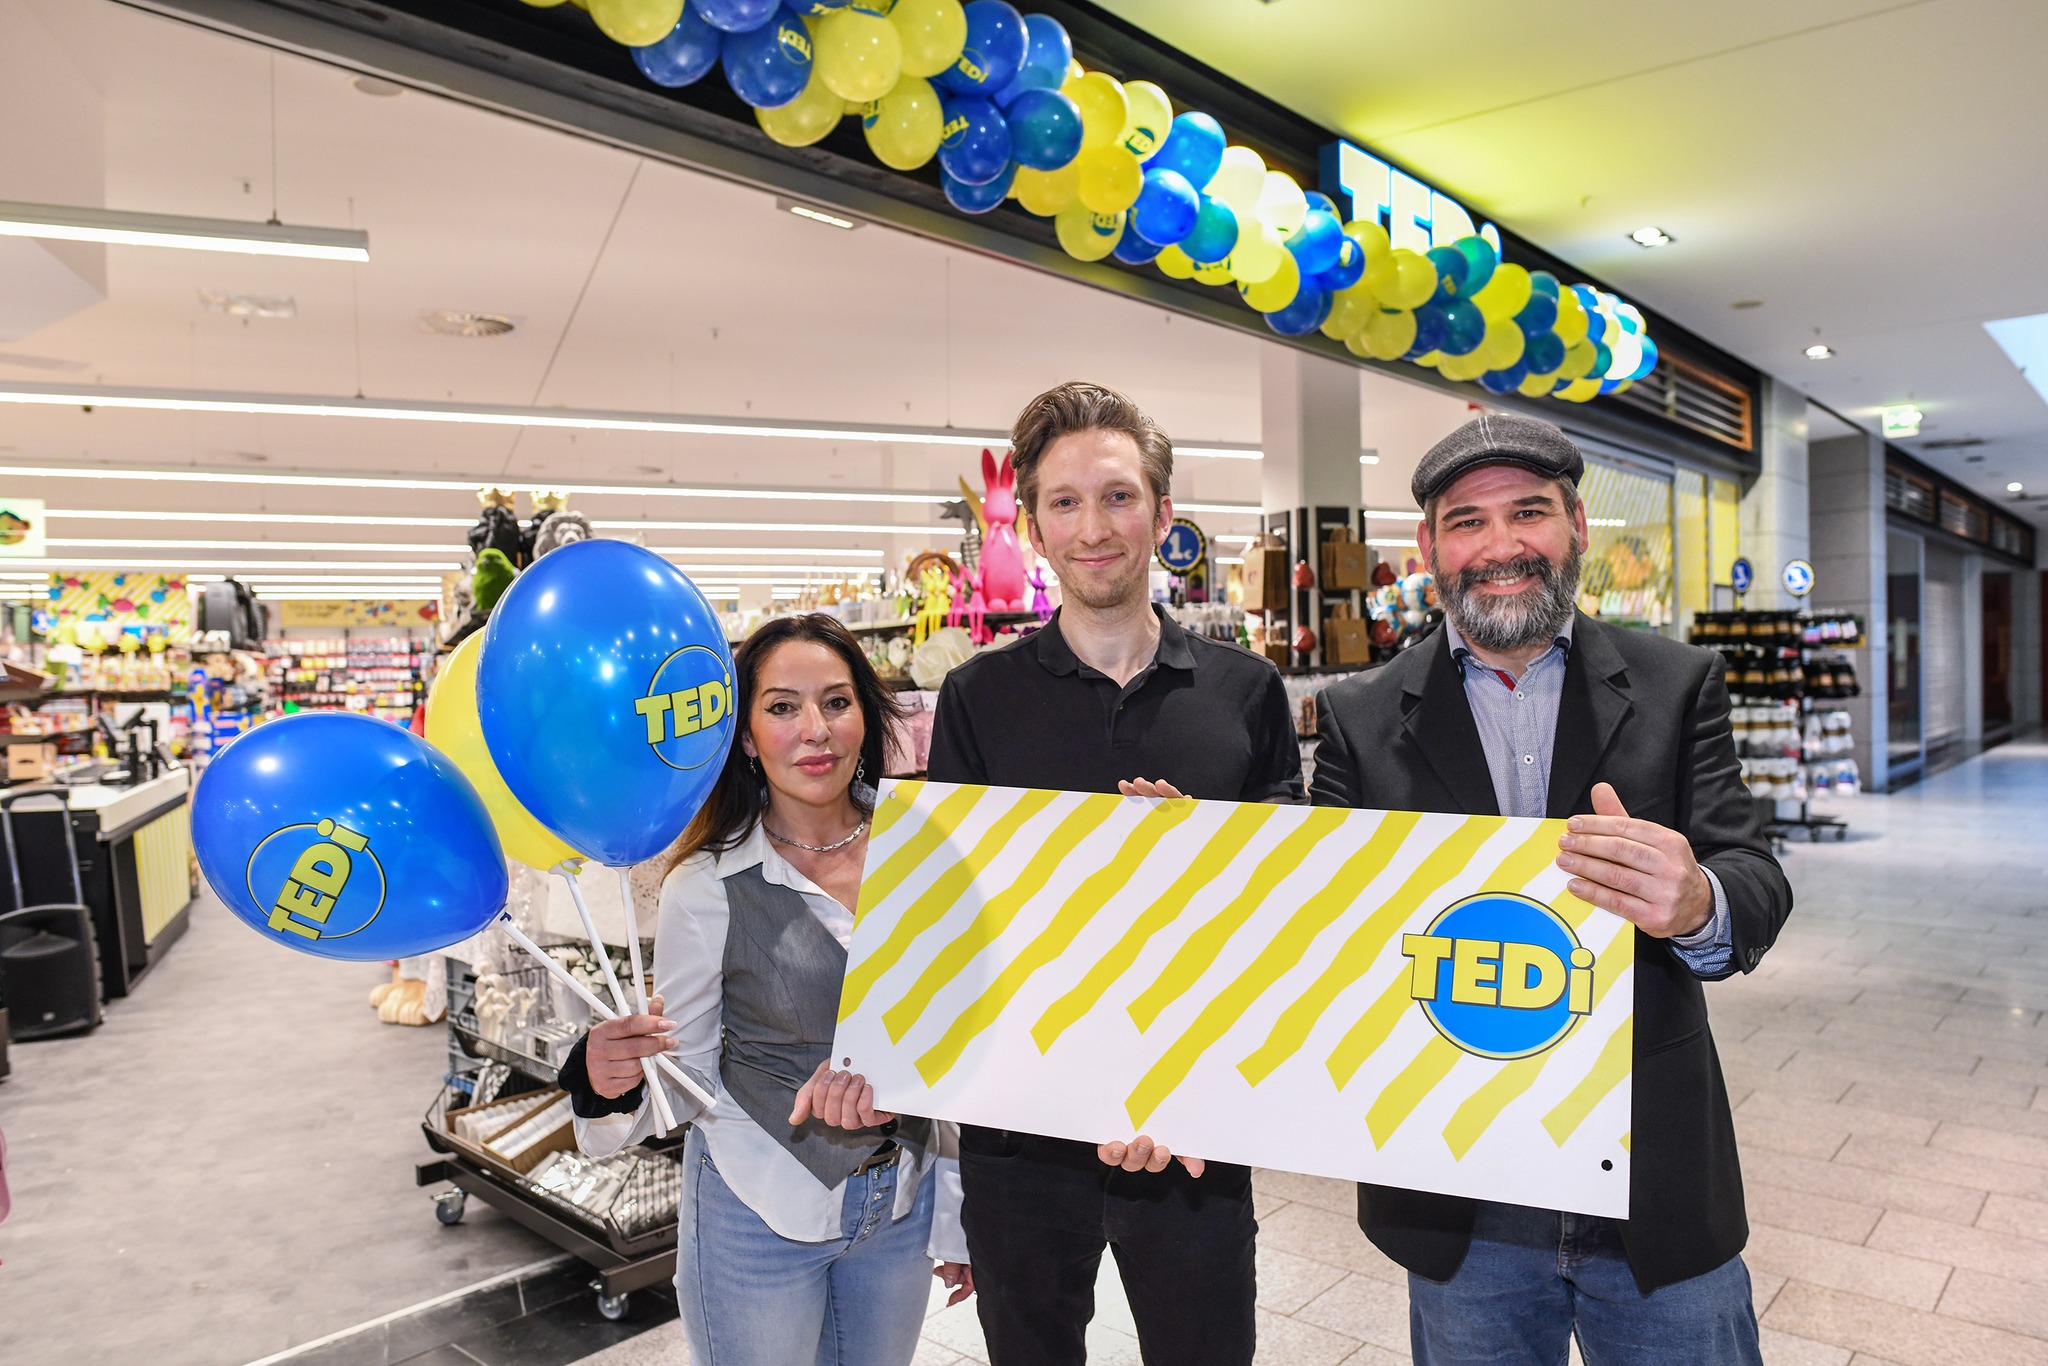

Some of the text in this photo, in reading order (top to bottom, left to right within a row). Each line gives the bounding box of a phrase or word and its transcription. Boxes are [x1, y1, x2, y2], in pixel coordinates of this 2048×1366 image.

[958, 55, 988, 84] EDi
[634, 671, 733, 745] TEDi
[267, 817, 371, 941] TEDi
[1401, 933, 1596, 1016] TEDi
